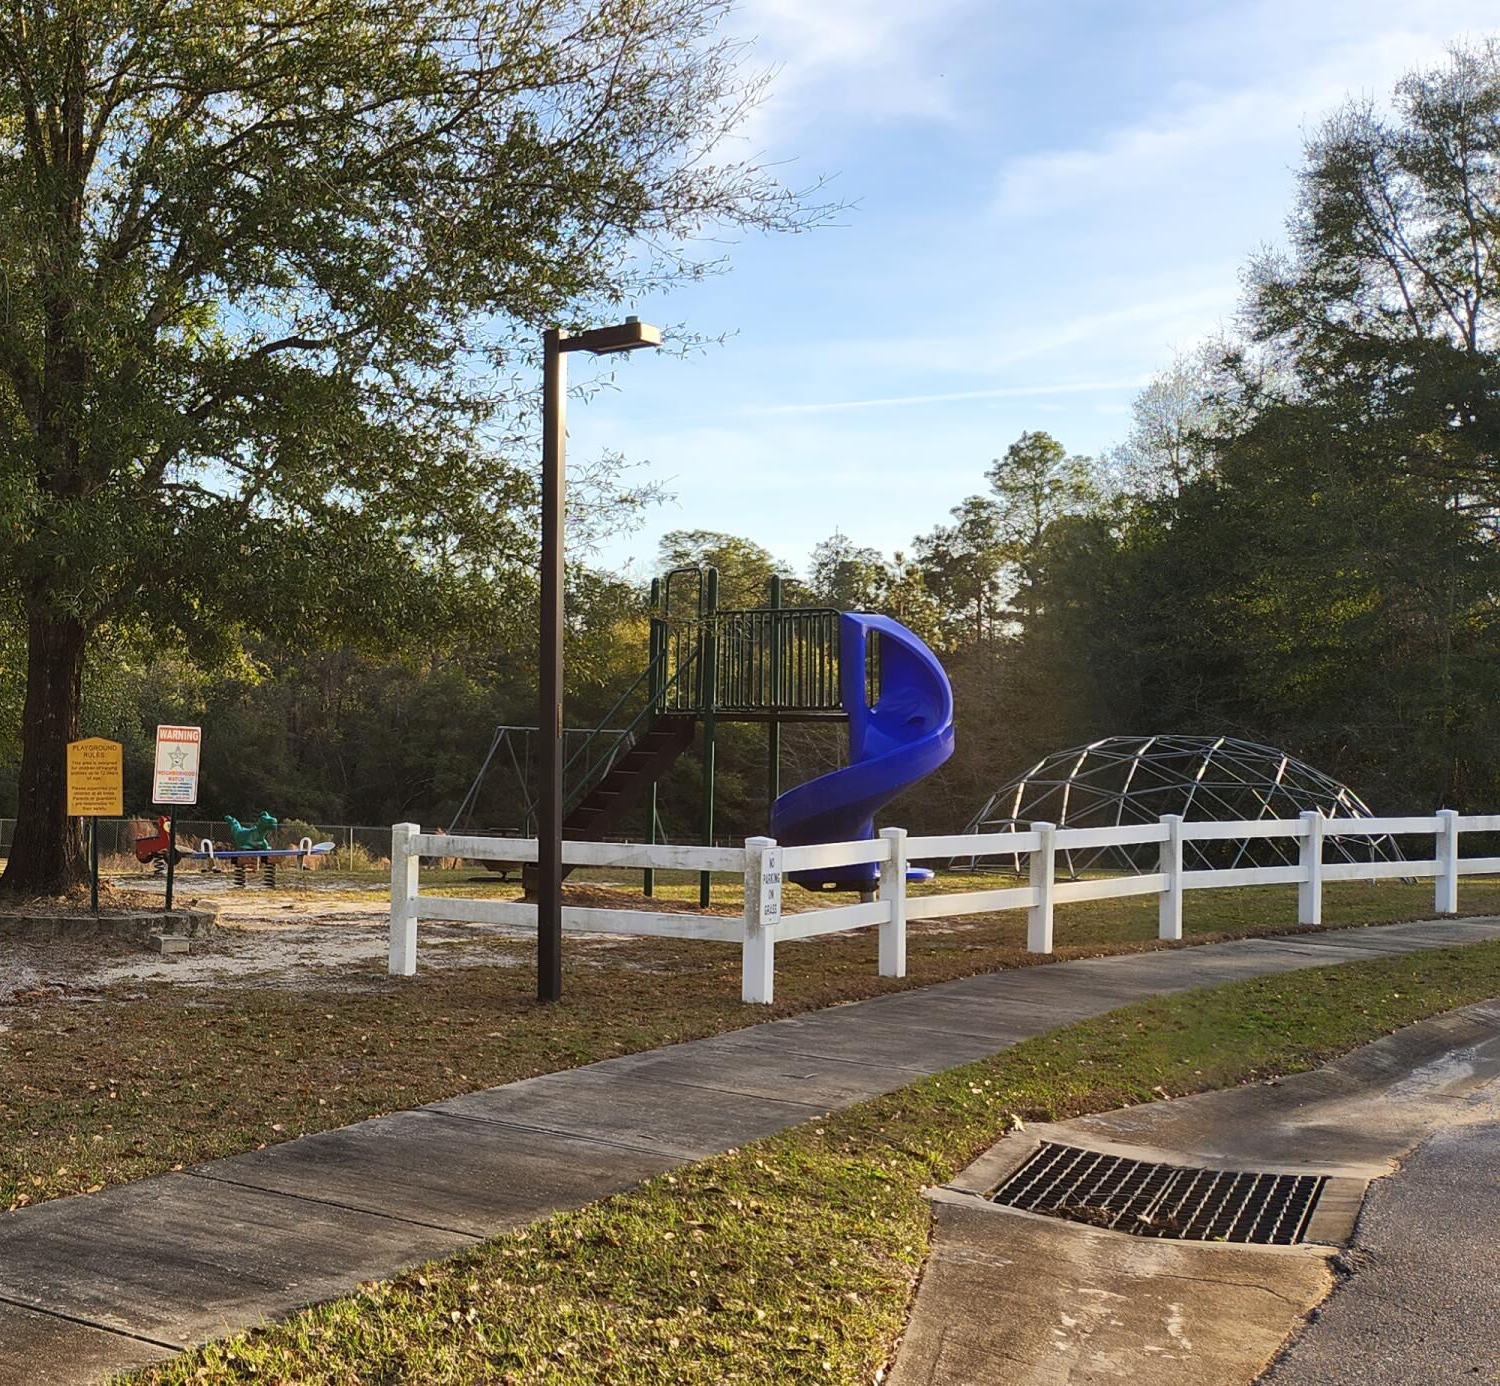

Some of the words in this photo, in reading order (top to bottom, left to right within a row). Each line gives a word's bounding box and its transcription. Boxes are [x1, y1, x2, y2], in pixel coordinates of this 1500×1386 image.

[160, 729, 198, 741] WARNING
[763, 873, 780, 884] PARKING
[764, 903, 777, 915] GRASS
